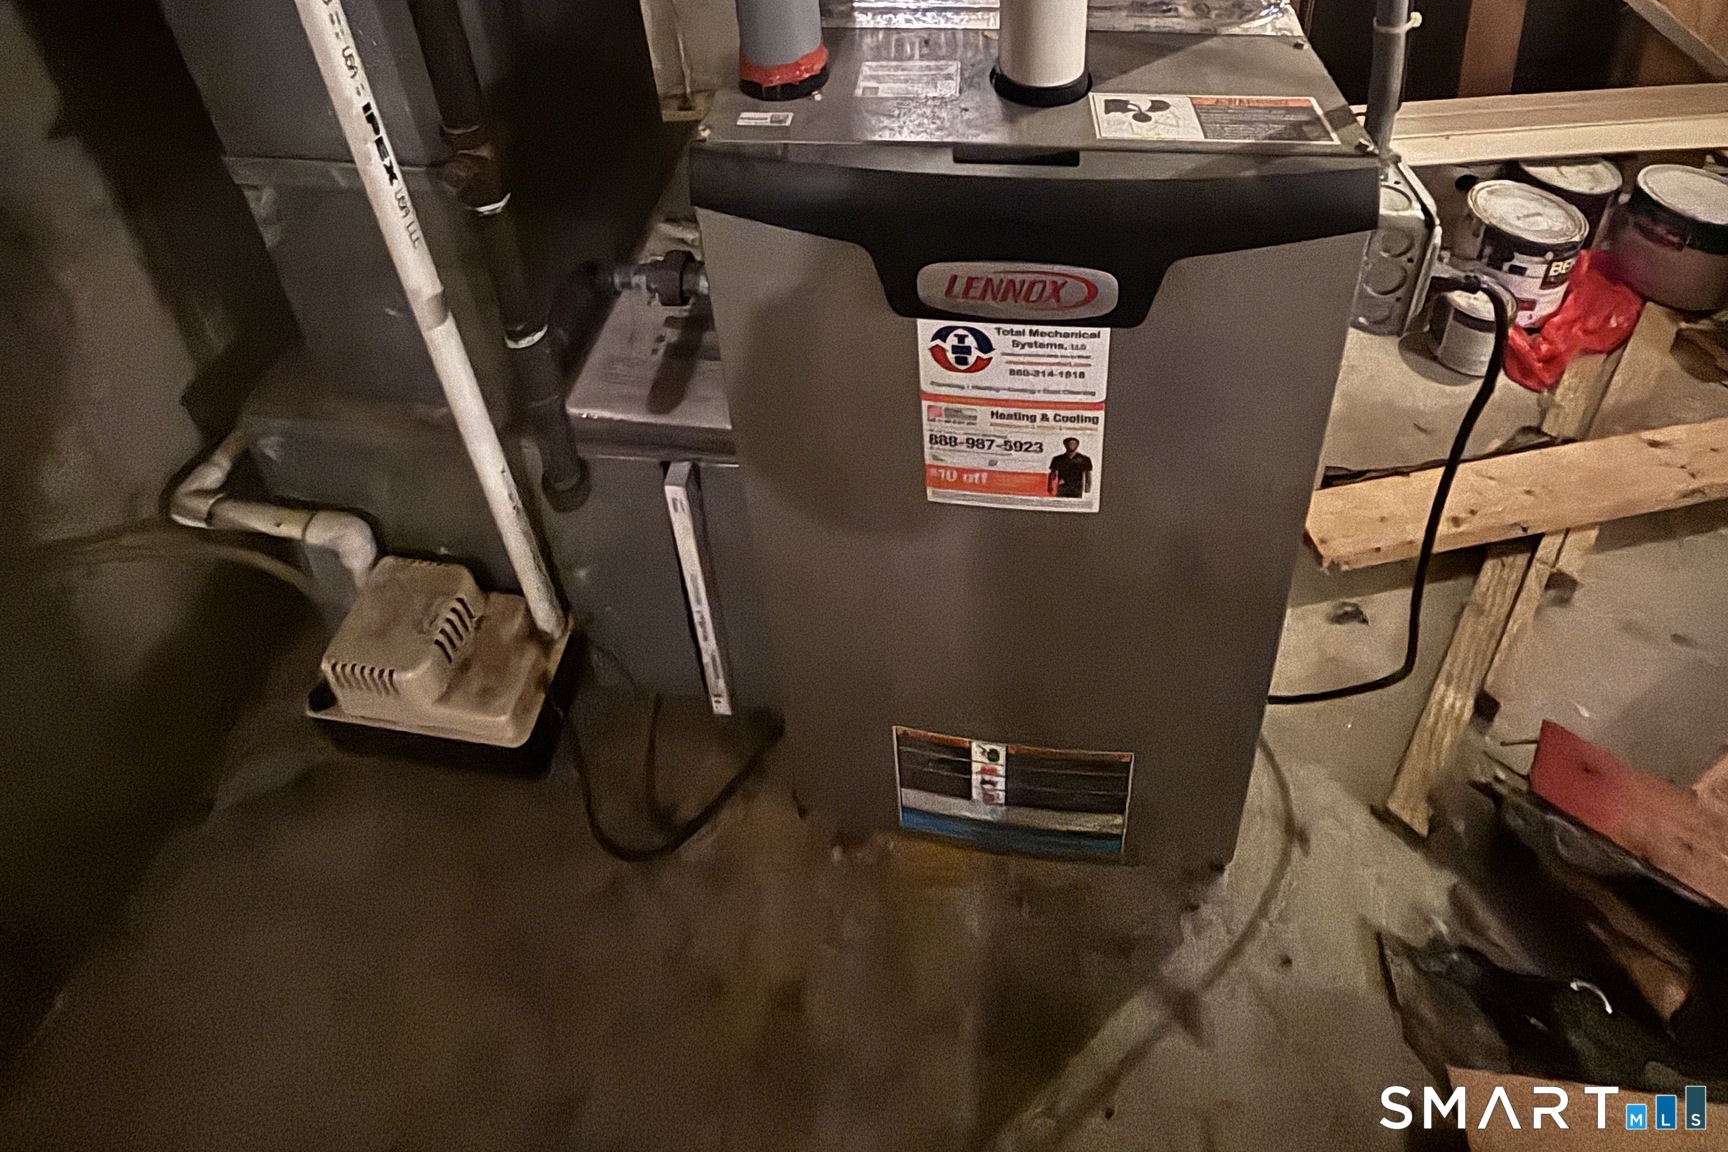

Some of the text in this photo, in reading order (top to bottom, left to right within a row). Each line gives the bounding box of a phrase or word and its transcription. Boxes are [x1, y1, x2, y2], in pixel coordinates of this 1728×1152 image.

[360, 101, 399, 186] IPEX
[944, 274, 1068, 304] LENNOX
[994, 327, 1101, 339] Total Mechanical
[1012, 339, 1068, 350] Systems,
[990, 410, 1037, 423] Heating
[1040, 412, 1050, 422] &
[1053, 413, 1100, 425] Cooling
